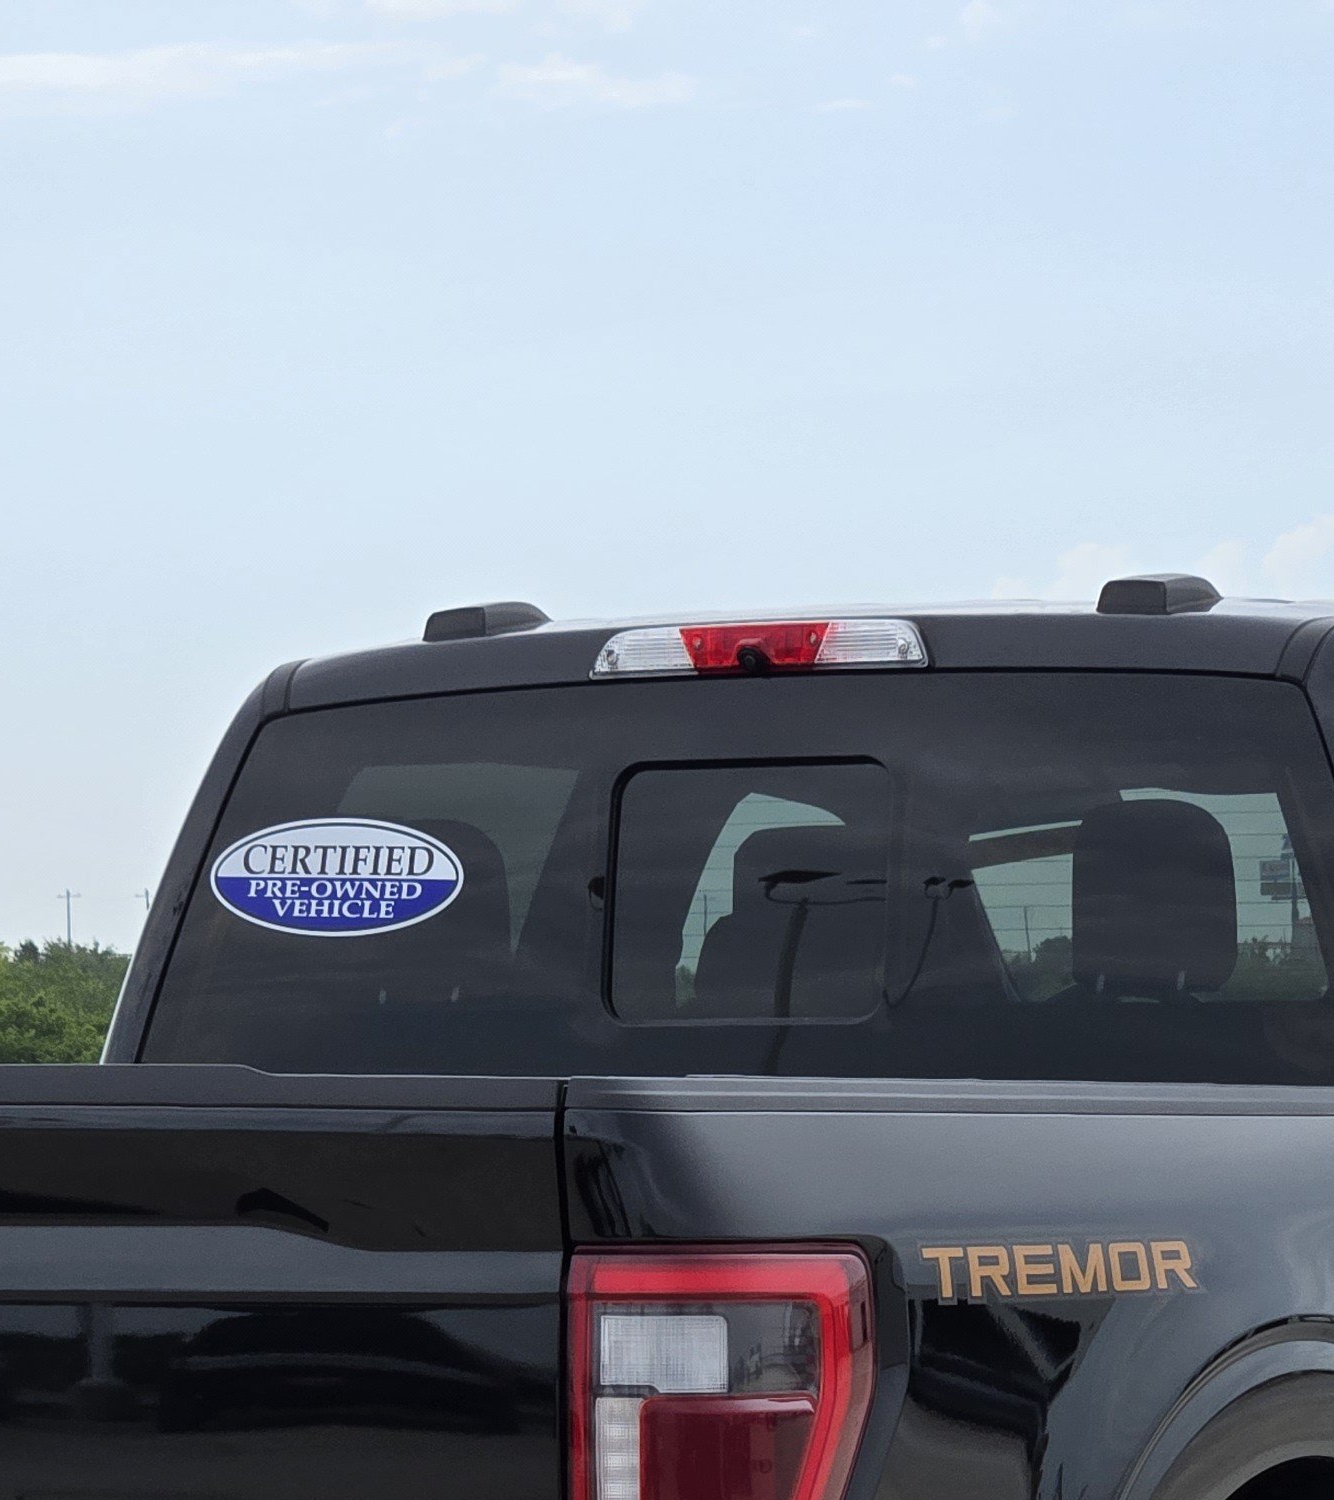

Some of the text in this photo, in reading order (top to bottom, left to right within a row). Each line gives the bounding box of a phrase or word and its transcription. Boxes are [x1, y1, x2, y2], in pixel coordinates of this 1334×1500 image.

[243, 843, 434, 877] CERTIFIED
[247, 880, 422, 900] PRE-OWNED
[272, 899, 395, 919] VEHICLE
[922, 1240, 1198, 1298] TREMOR
